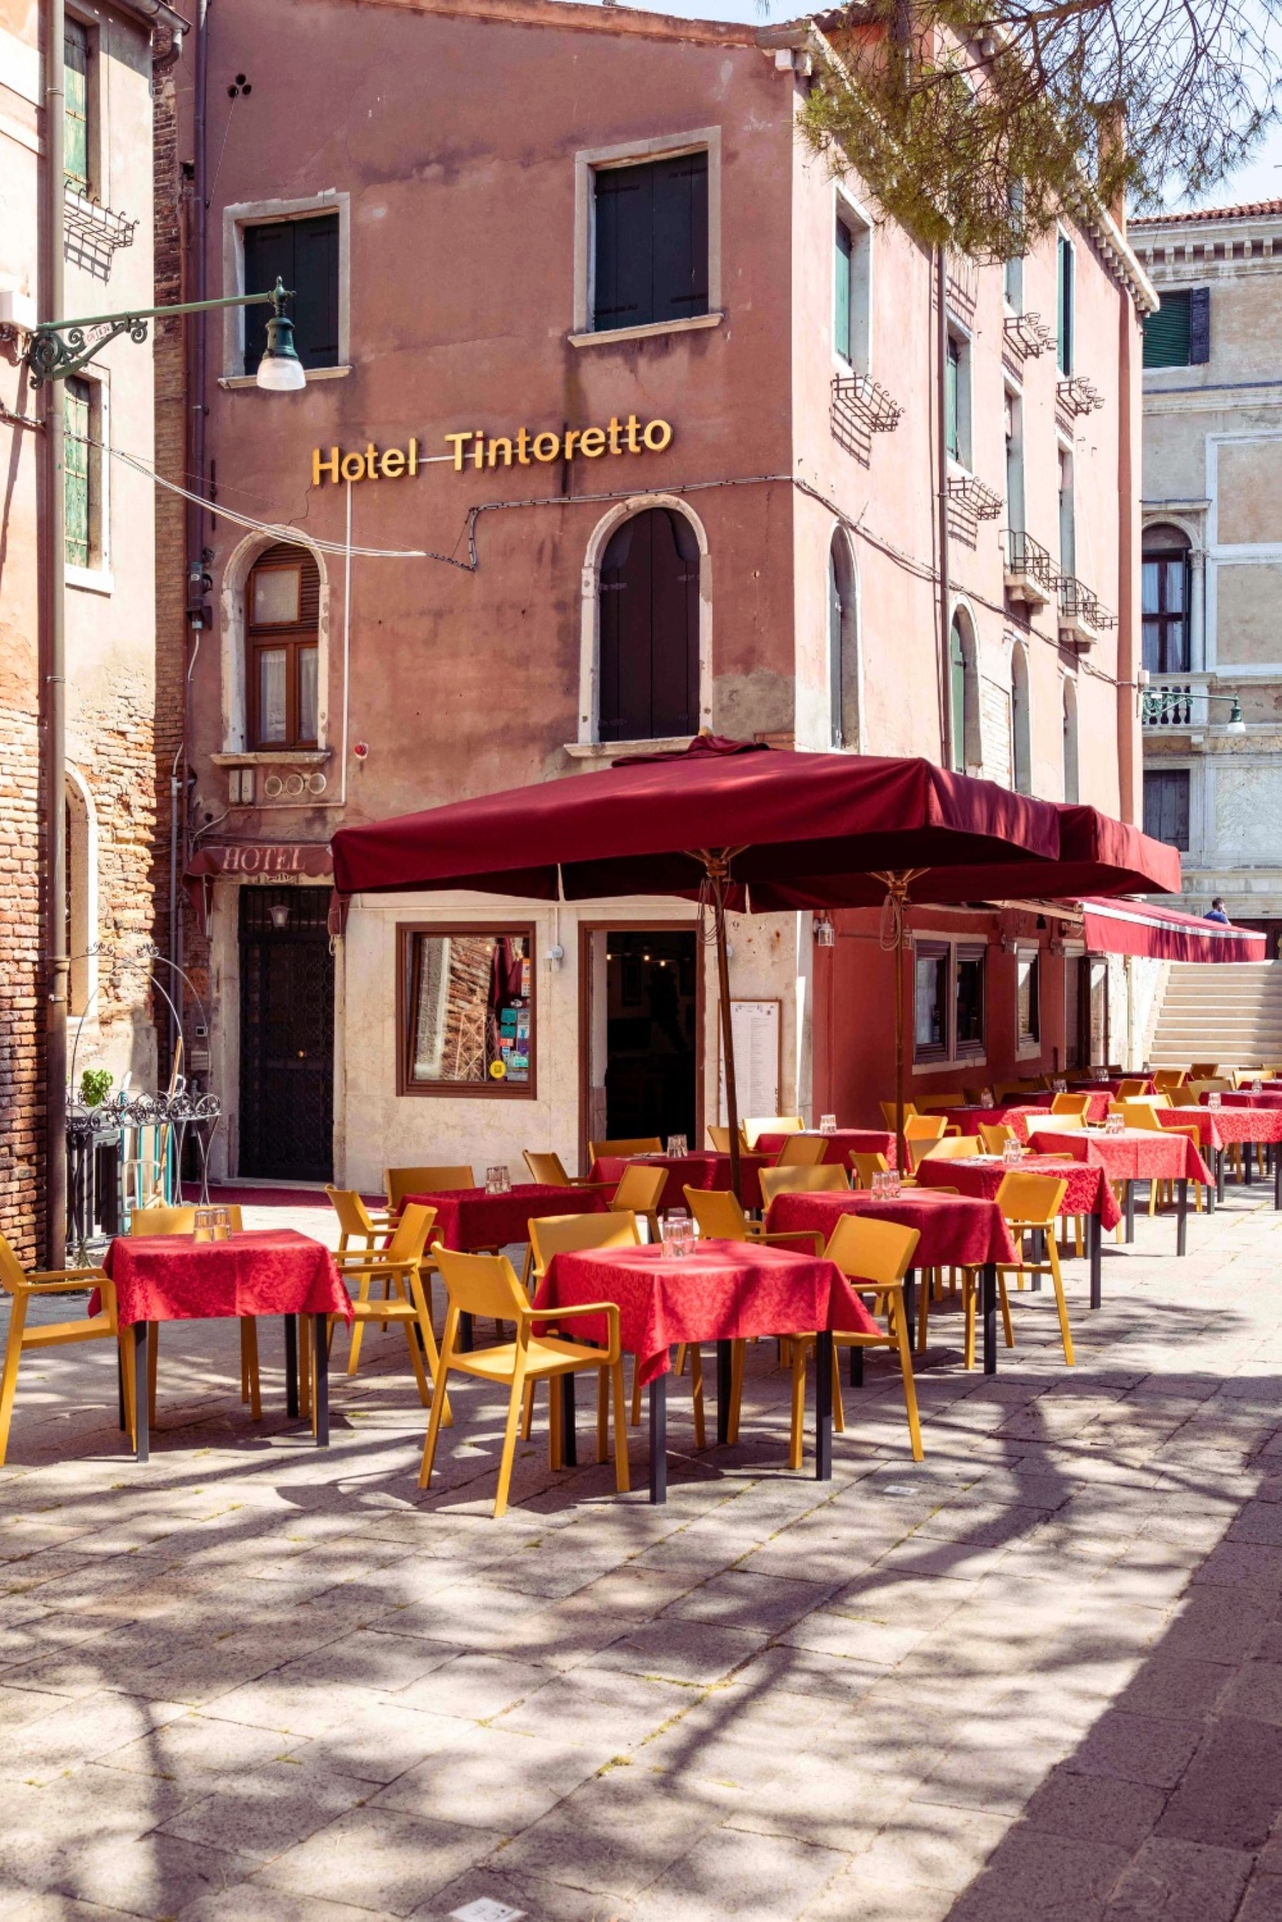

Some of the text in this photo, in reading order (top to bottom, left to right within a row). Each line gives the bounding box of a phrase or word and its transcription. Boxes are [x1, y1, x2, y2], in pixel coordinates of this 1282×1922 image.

[312, 414, 673, 485] Hotel Tintoretto
[222, 847, 305, 870] HOTEL
